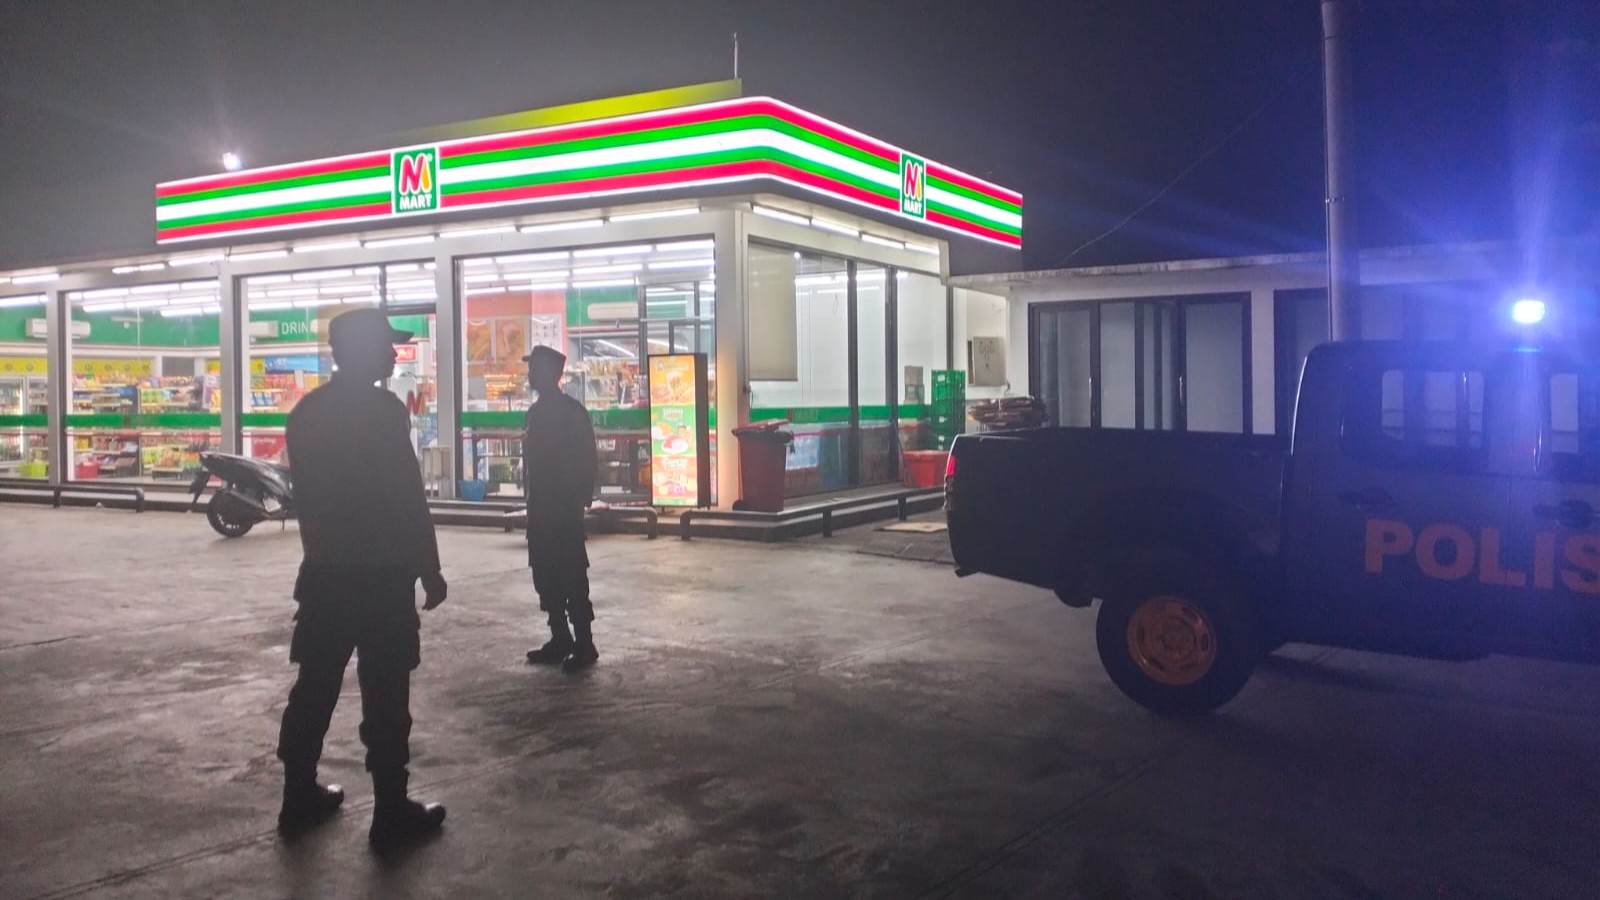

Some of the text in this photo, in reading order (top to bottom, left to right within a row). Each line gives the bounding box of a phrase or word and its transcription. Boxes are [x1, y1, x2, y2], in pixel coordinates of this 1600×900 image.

[400, 193, 432, 210] MART
[904, 197, 923, 215] MART
[1364, 517, 1600, 595] POLIS
